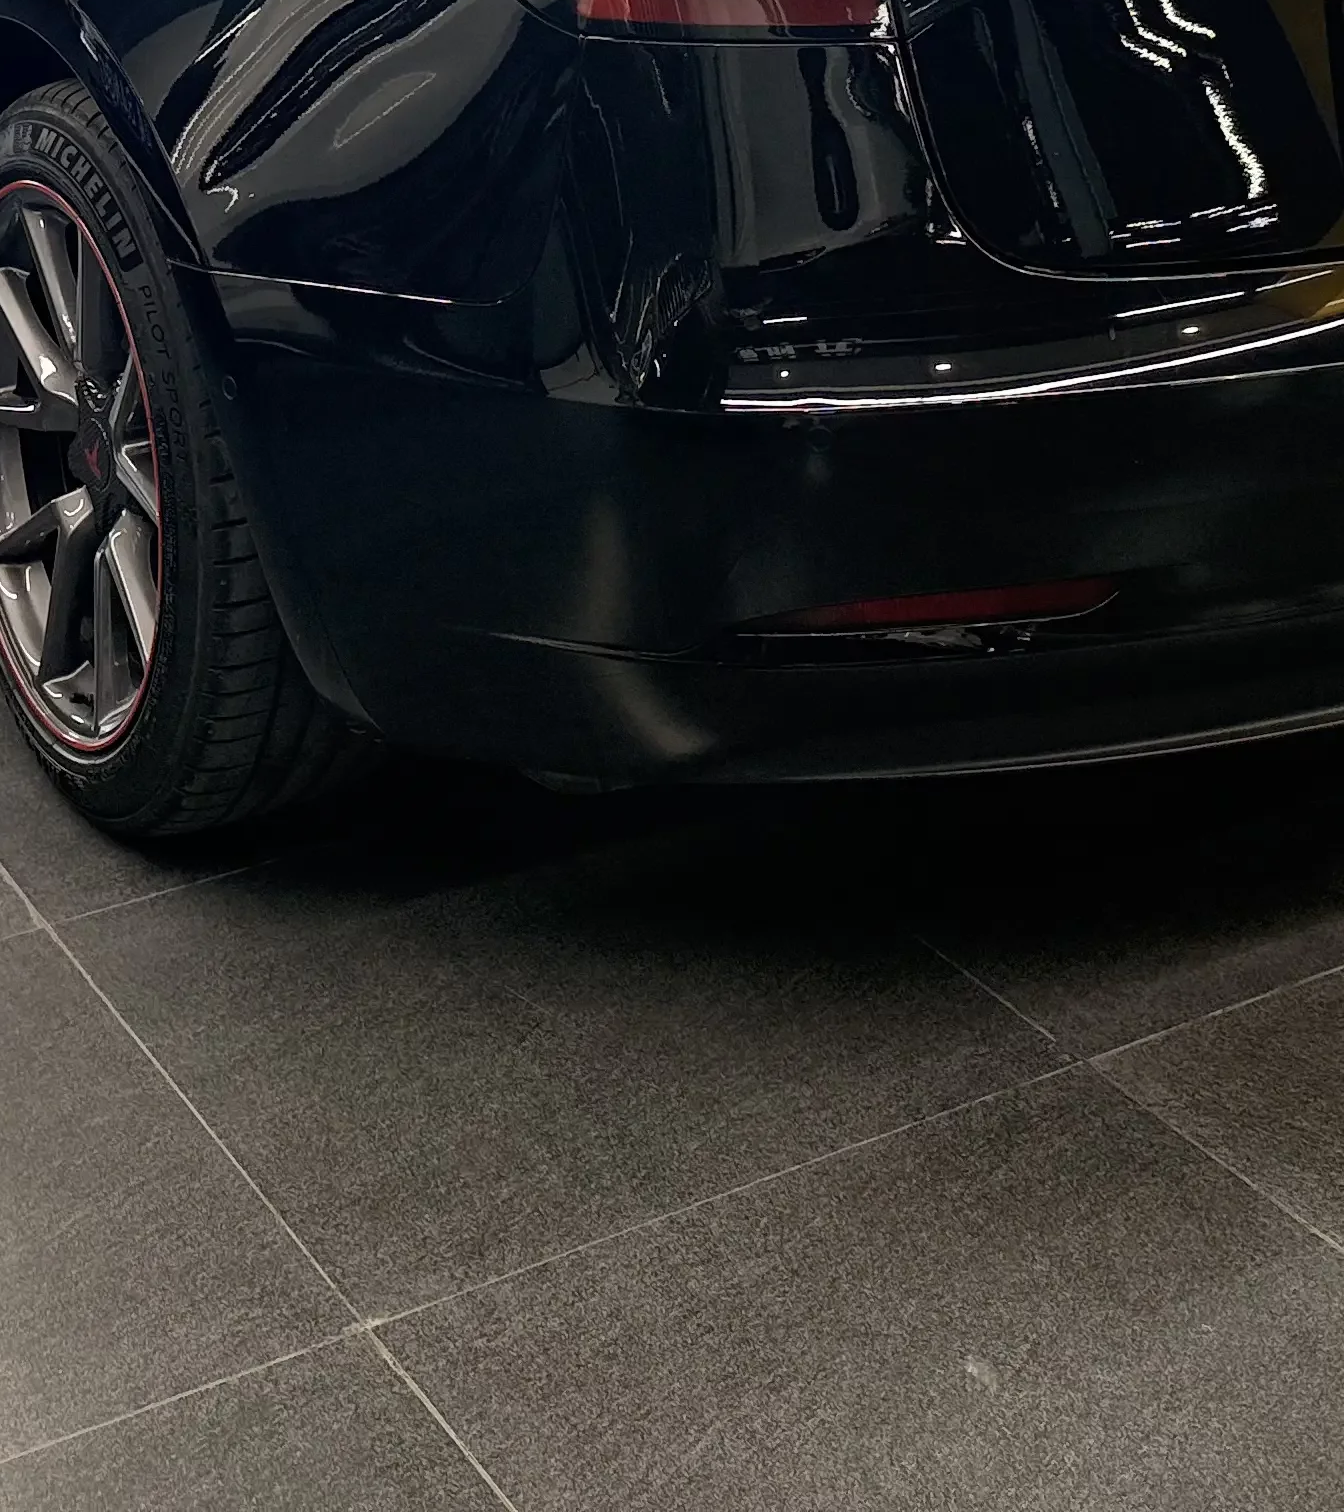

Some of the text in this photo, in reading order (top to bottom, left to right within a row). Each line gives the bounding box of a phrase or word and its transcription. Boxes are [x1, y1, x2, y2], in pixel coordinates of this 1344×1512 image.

[34, 127, 136, 259] MICHELIN
[138, 284, 171, 360] PILOT
[162, 368, 188, 463] SPORT
